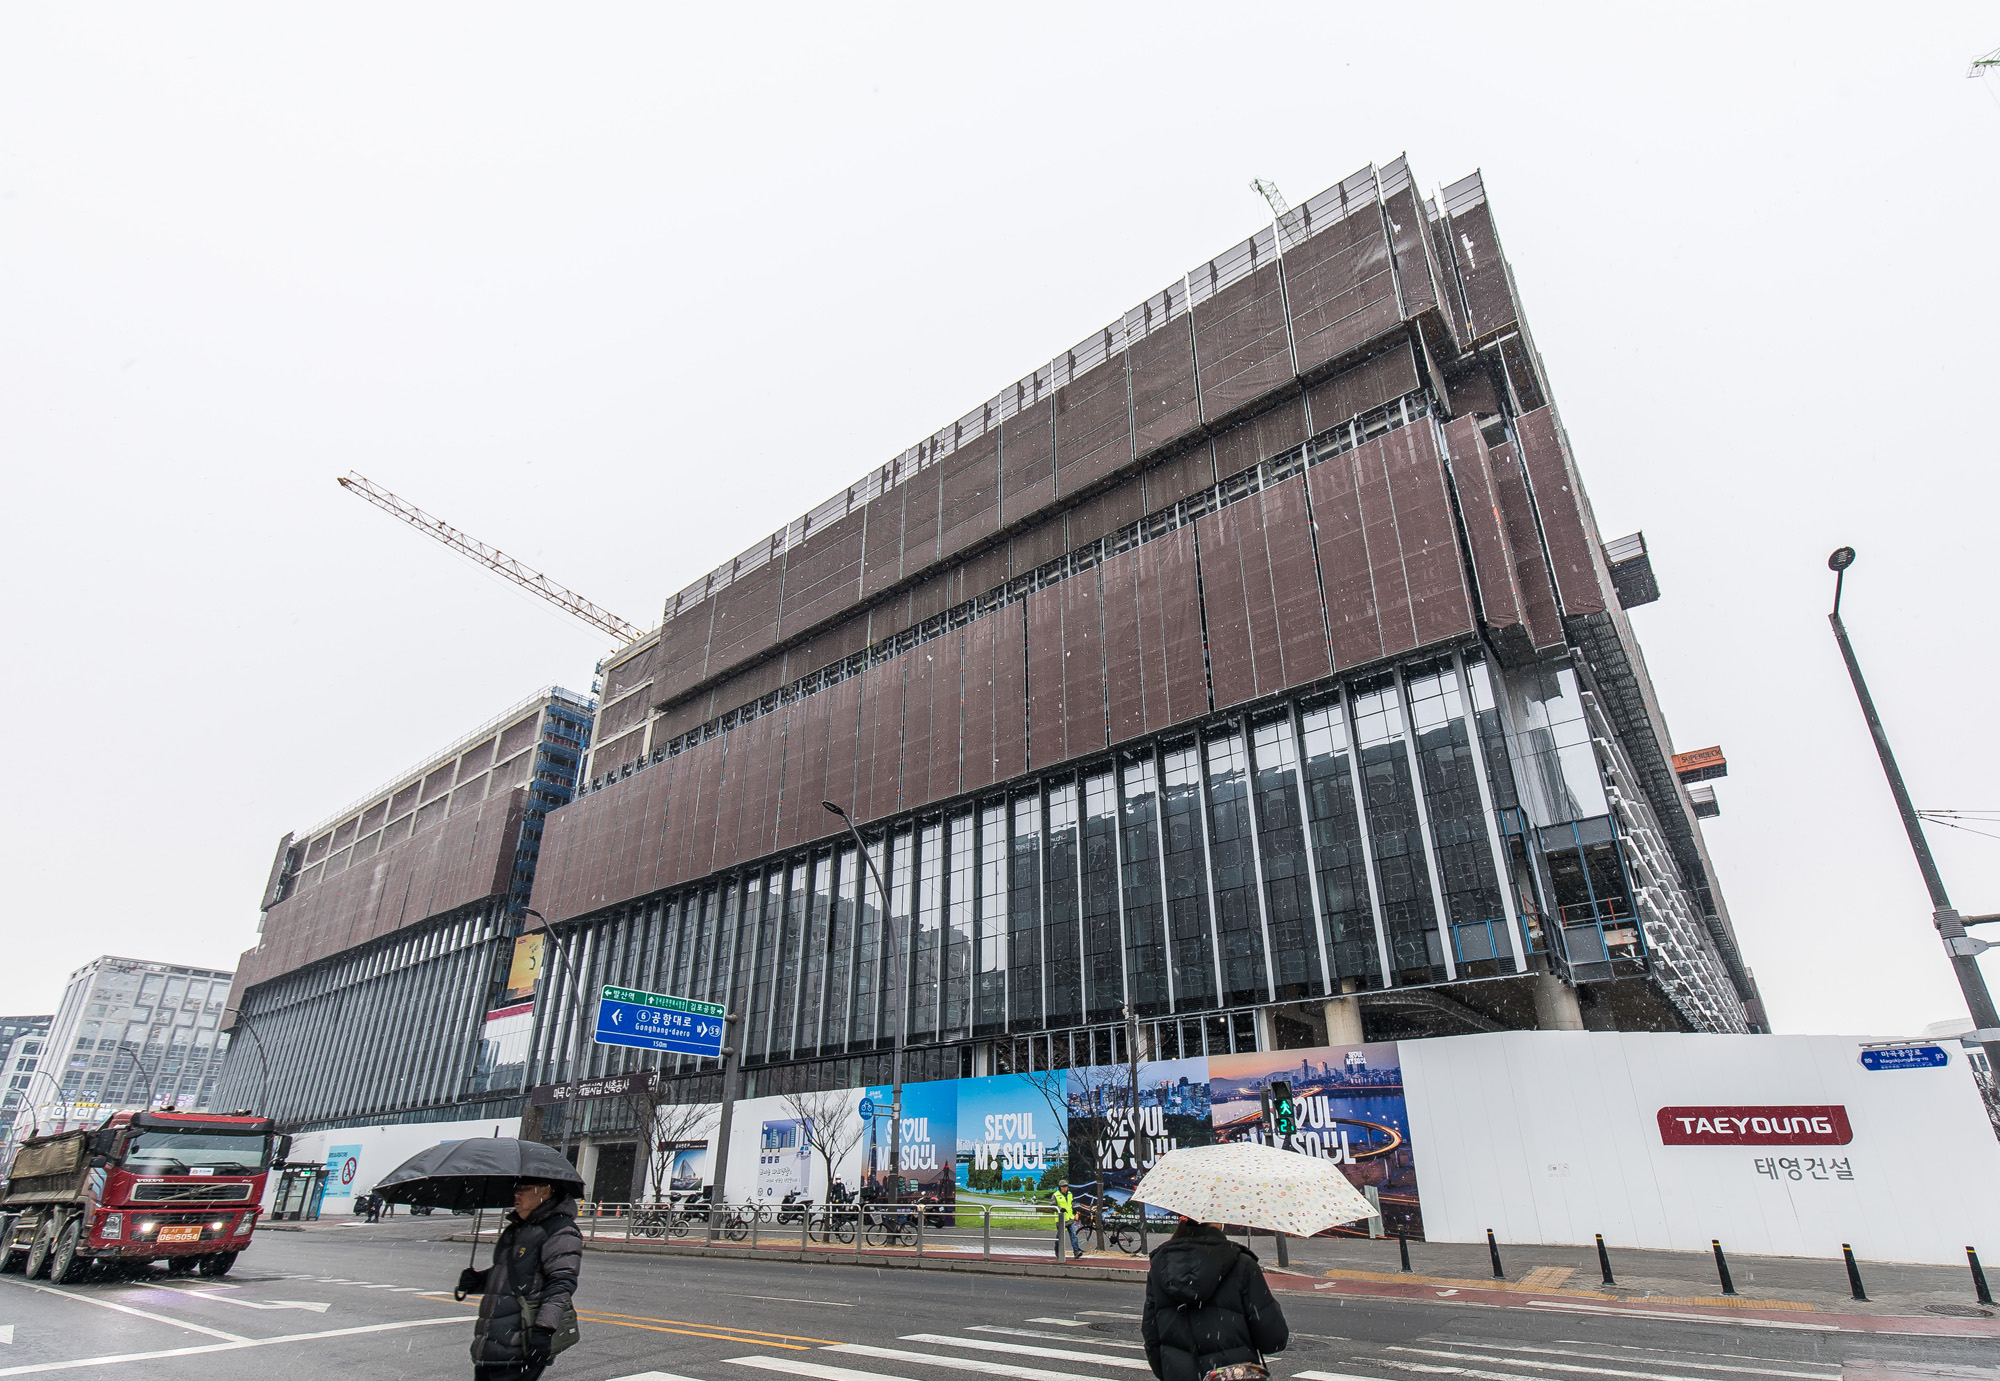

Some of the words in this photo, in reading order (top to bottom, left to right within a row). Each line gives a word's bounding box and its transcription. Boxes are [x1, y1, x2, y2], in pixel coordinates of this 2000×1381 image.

[1681, 750, 1721, 763] SUPERDECK
[613, 989, 635, 1001] 발산역
[690, 1002, 716, 1014] 김포공항
[618, 1013, 623, 1022] E
[651, 1011, 692, 1027] 공항대로
[696, 1025, 702, 1033] W
[709, 1027, 719, 1036] 39
[653, 1040, 667, 1049] 150m
[1880, 1048, 1923, 1058] 마곡중앙로
[1934, 1053, 1945, 1061] 93
[553, 1087, 565, 1099] 마곡
[603, 1079, 629, 1094] 신축공사
[984, 1112, 1036, 1142] SEOUL
[1106, 1106, 1169, 1138] SEOUL
[1675, 1116, 1833, 1135] TAEYOUNG
[1002, 1141, 1047, 1171] SOUL
[1290, 1131, 1357, 1165] SOUL
[900, 1143, 939, 1171] SOUL
[1753, 1157, 1855, 1181] 태영건설
